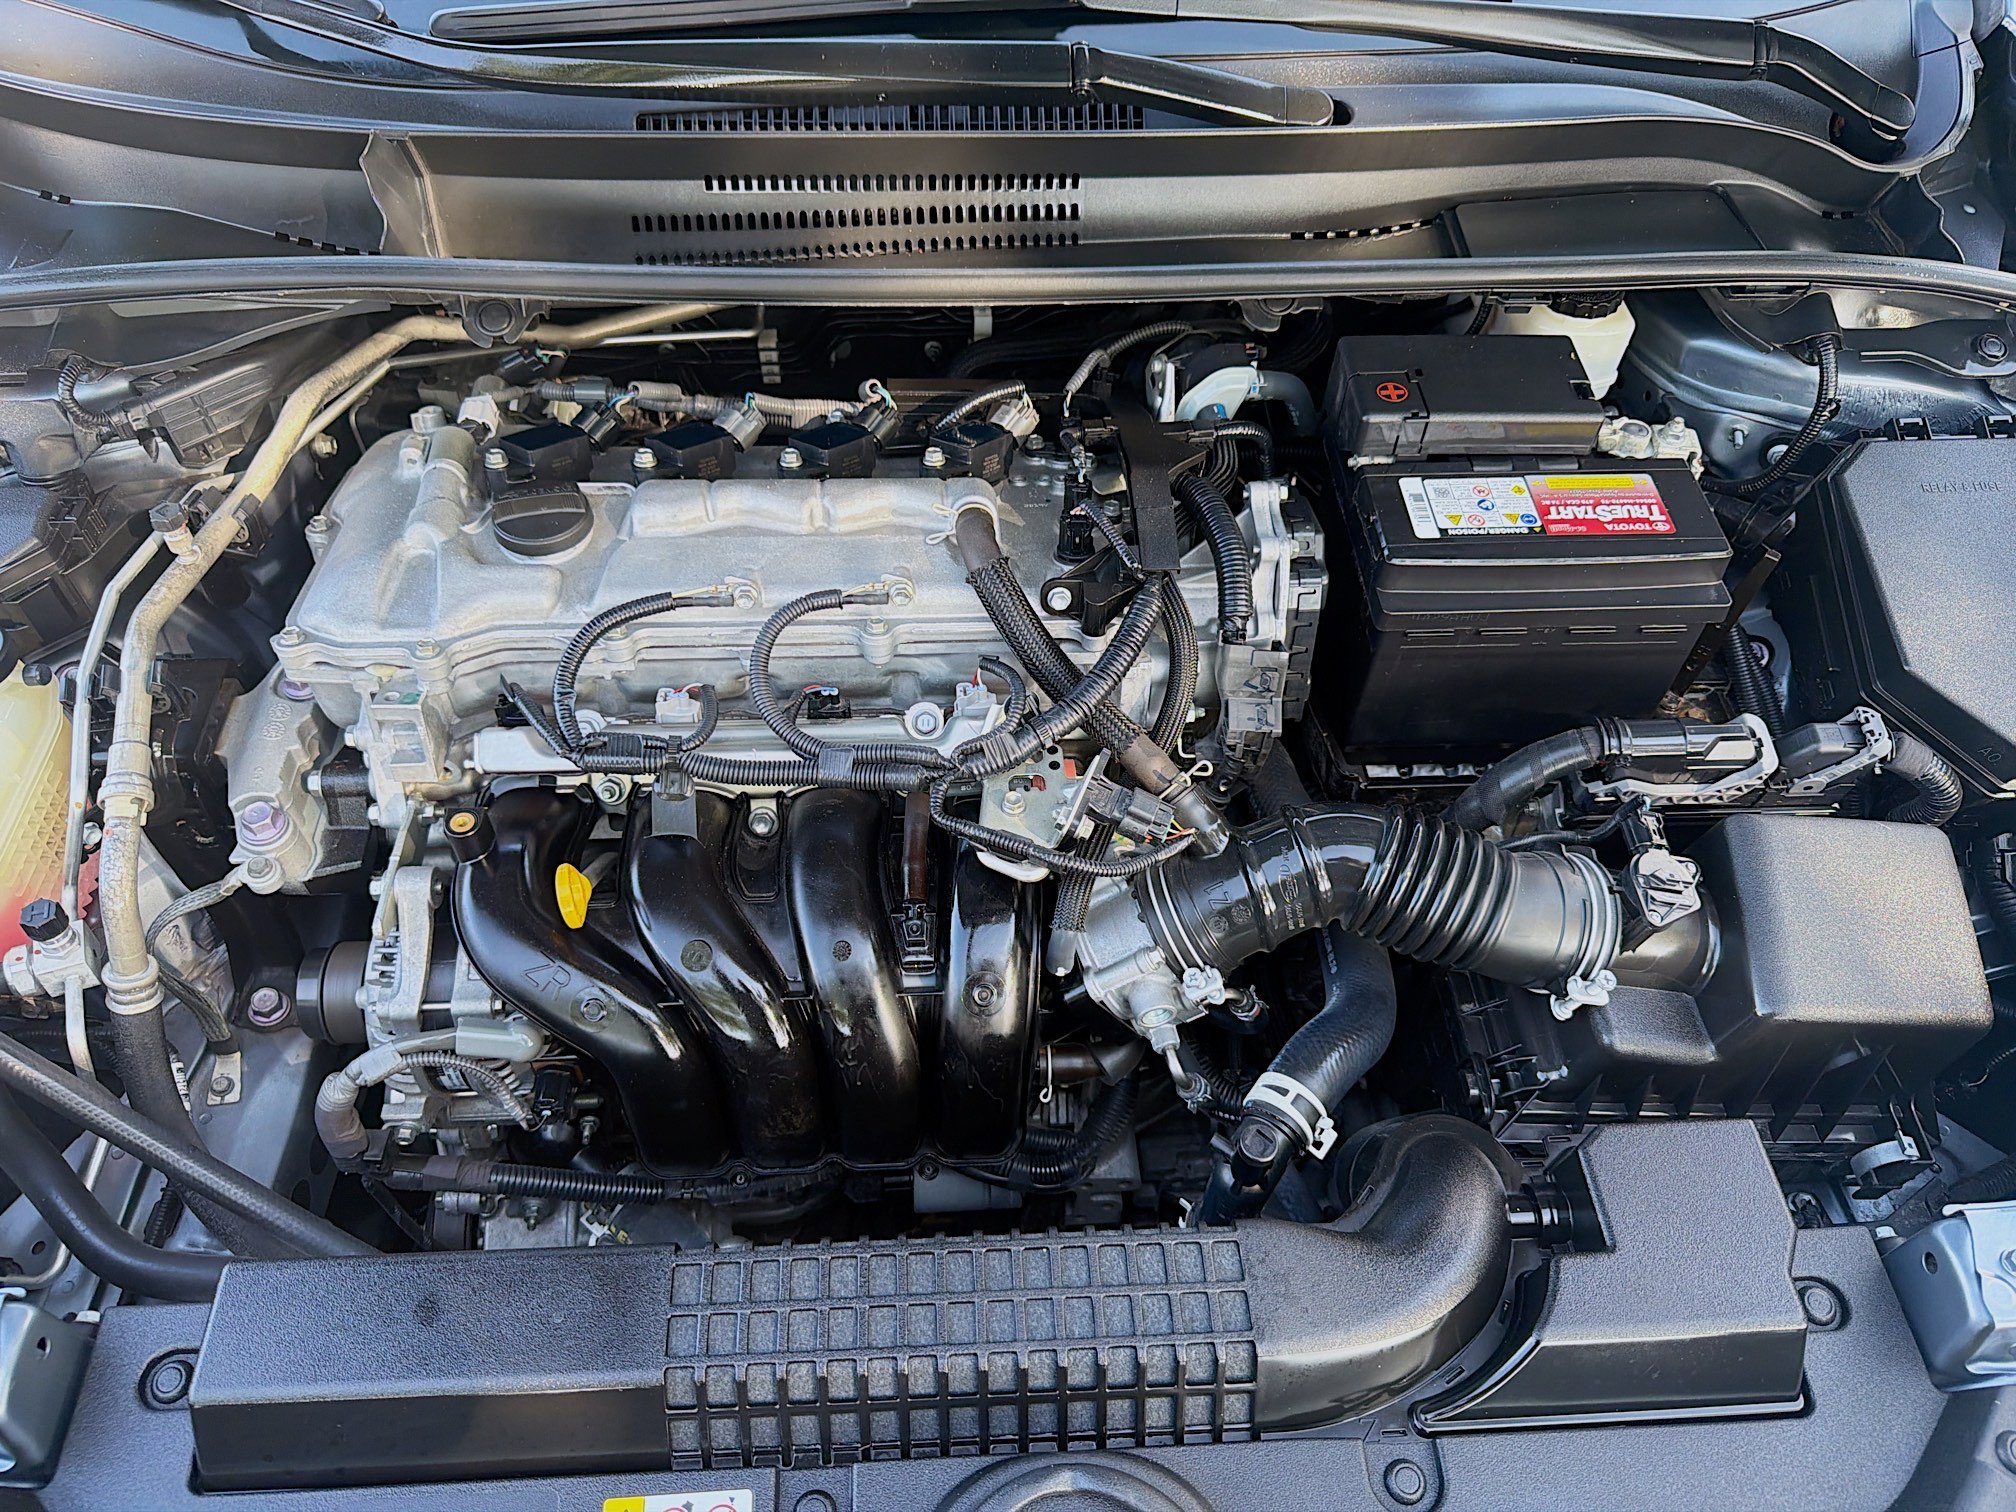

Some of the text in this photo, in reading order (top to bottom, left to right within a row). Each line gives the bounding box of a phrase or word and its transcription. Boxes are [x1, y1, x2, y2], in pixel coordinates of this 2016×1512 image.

[1920, 481, 2003, 493] RELAY & FUSE
[1447, 527, 1530, 536] DANGER/POISON
[1603, 522, 1652, 531] TOYOTA
[26, 901, 51, 923] H
